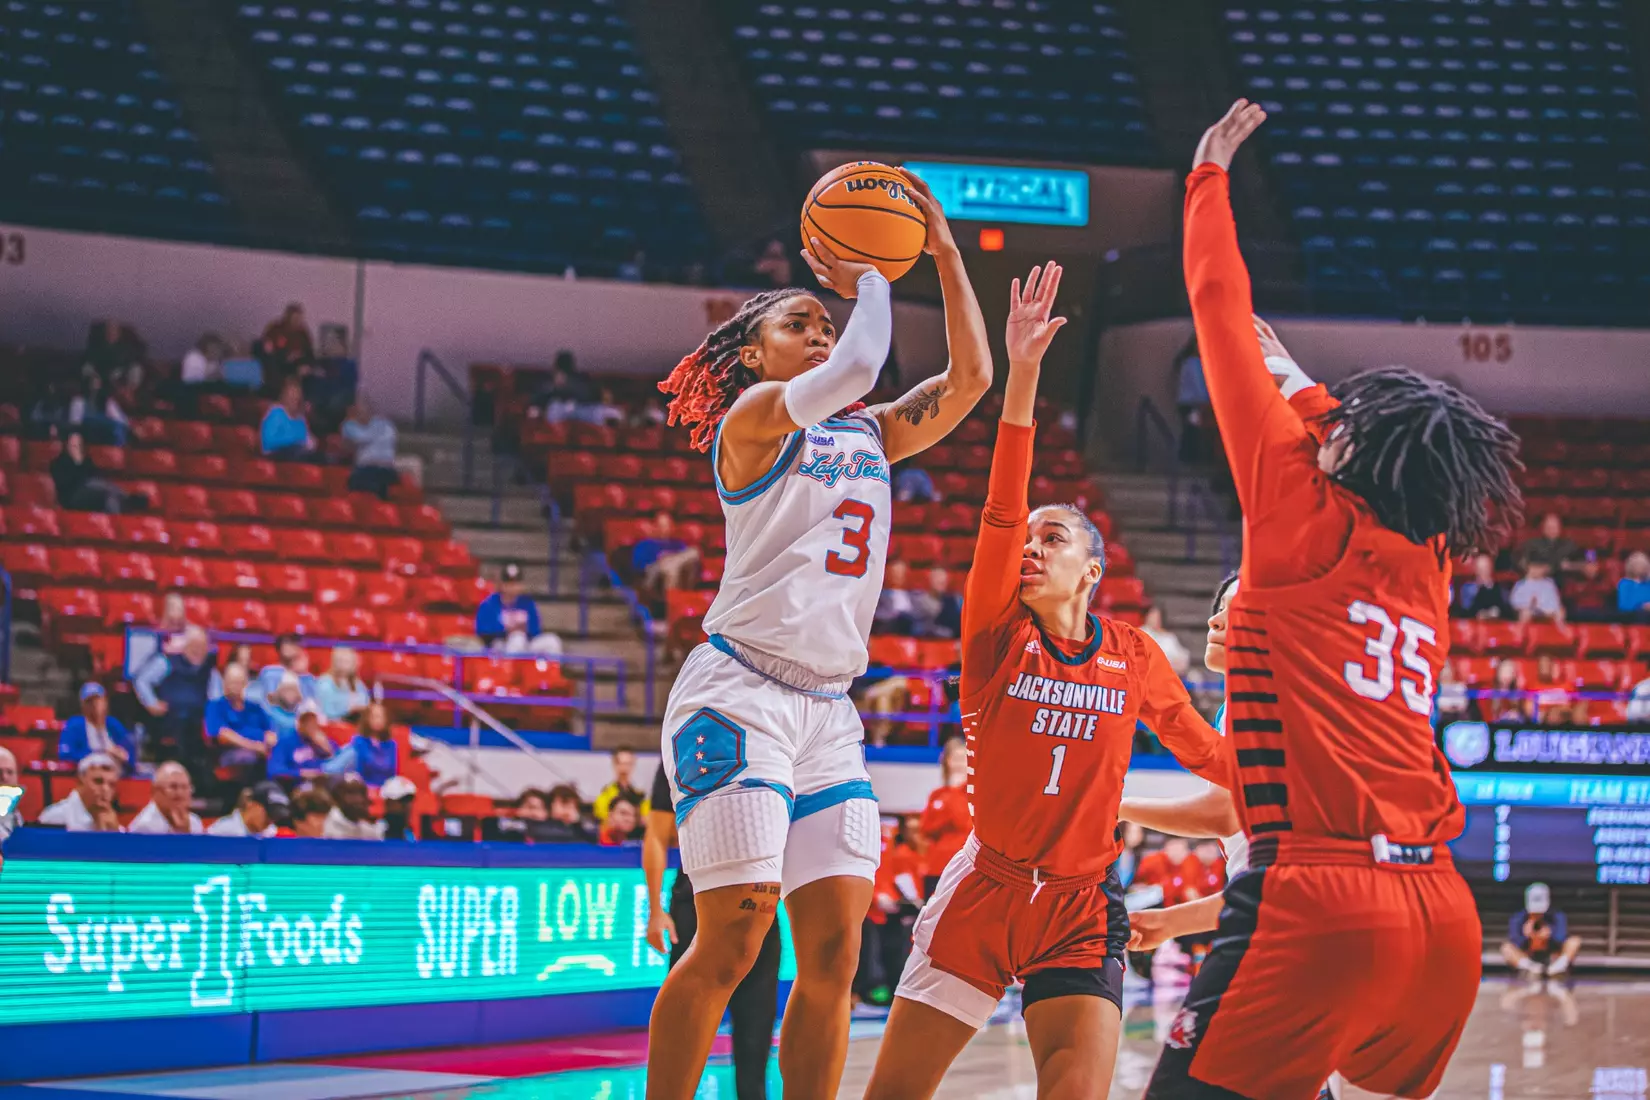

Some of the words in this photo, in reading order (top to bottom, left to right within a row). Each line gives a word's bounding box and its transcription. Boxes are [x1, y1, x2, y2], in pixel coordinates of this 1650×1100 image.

[0, 232, 26, 266] 3
[1460, 333, 1512, 362] 105
[797, 449, 846, 488] Lady
[825, 497, 875, 579] 3
[1344, 600, 1436, 716] 35
[1007, 672, 1126, 715] JACKSONVILLE
[1031, 708, 1098, 741] STATE
[1043, 744, 1067, 796] 1
[43, 893, 191, 992] Super
[236, 893, 363, 966] Foods
[416, 884, 518, 979] SUPER
[537, 878, 620, 942] LOW
